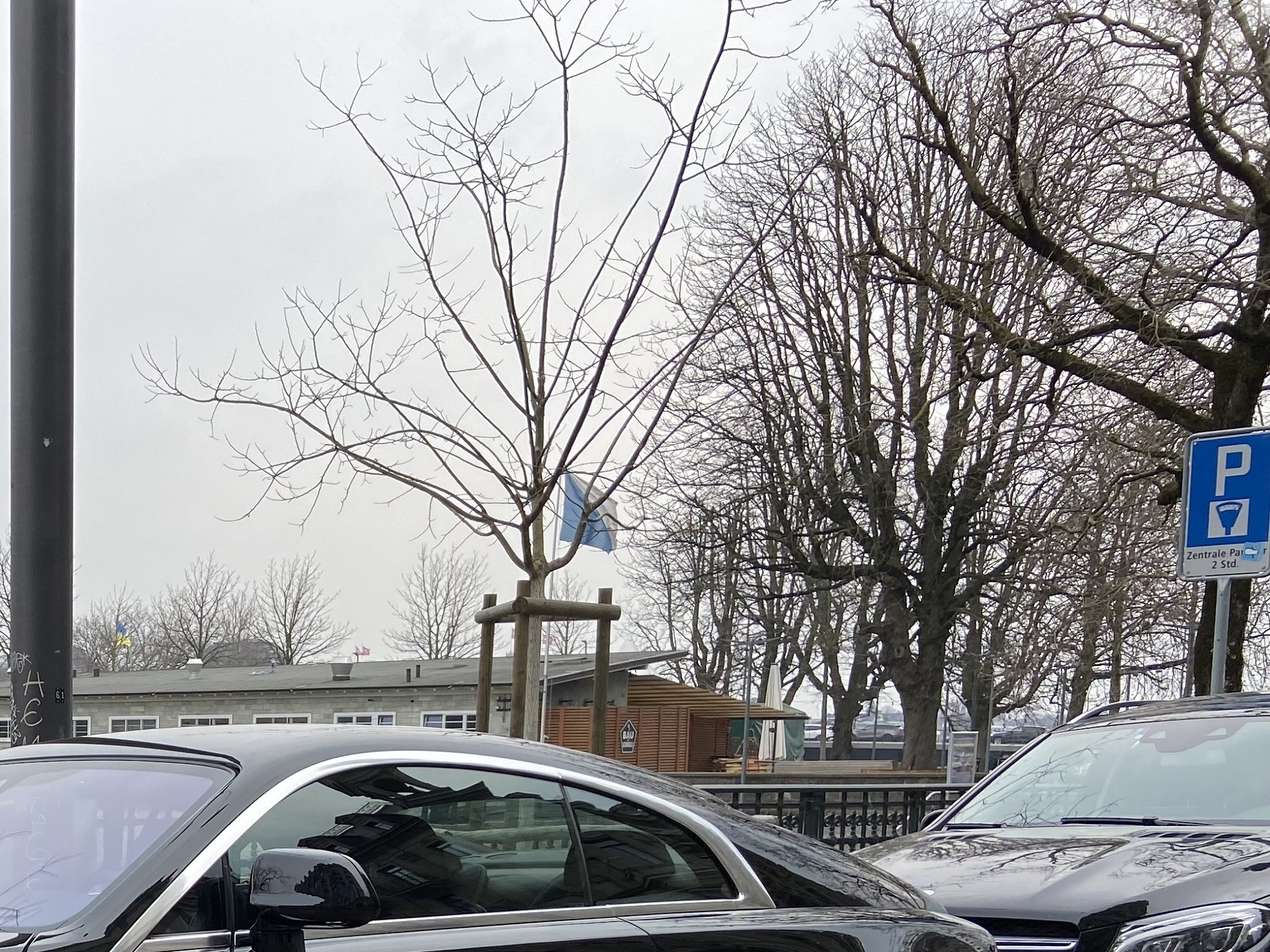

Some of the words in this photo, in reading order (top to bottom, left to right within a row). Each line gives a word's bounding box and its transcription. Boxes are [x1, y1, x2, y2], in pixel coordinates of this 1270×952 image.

[1215, 443, 1252, 497] P
[1186, 549, 1227, 560] Zentrale
[1229, 548, 1268, 557] Parr
[1211, 561, 1218, 569] 2
[1220, 559, 1239, 569] Std.
